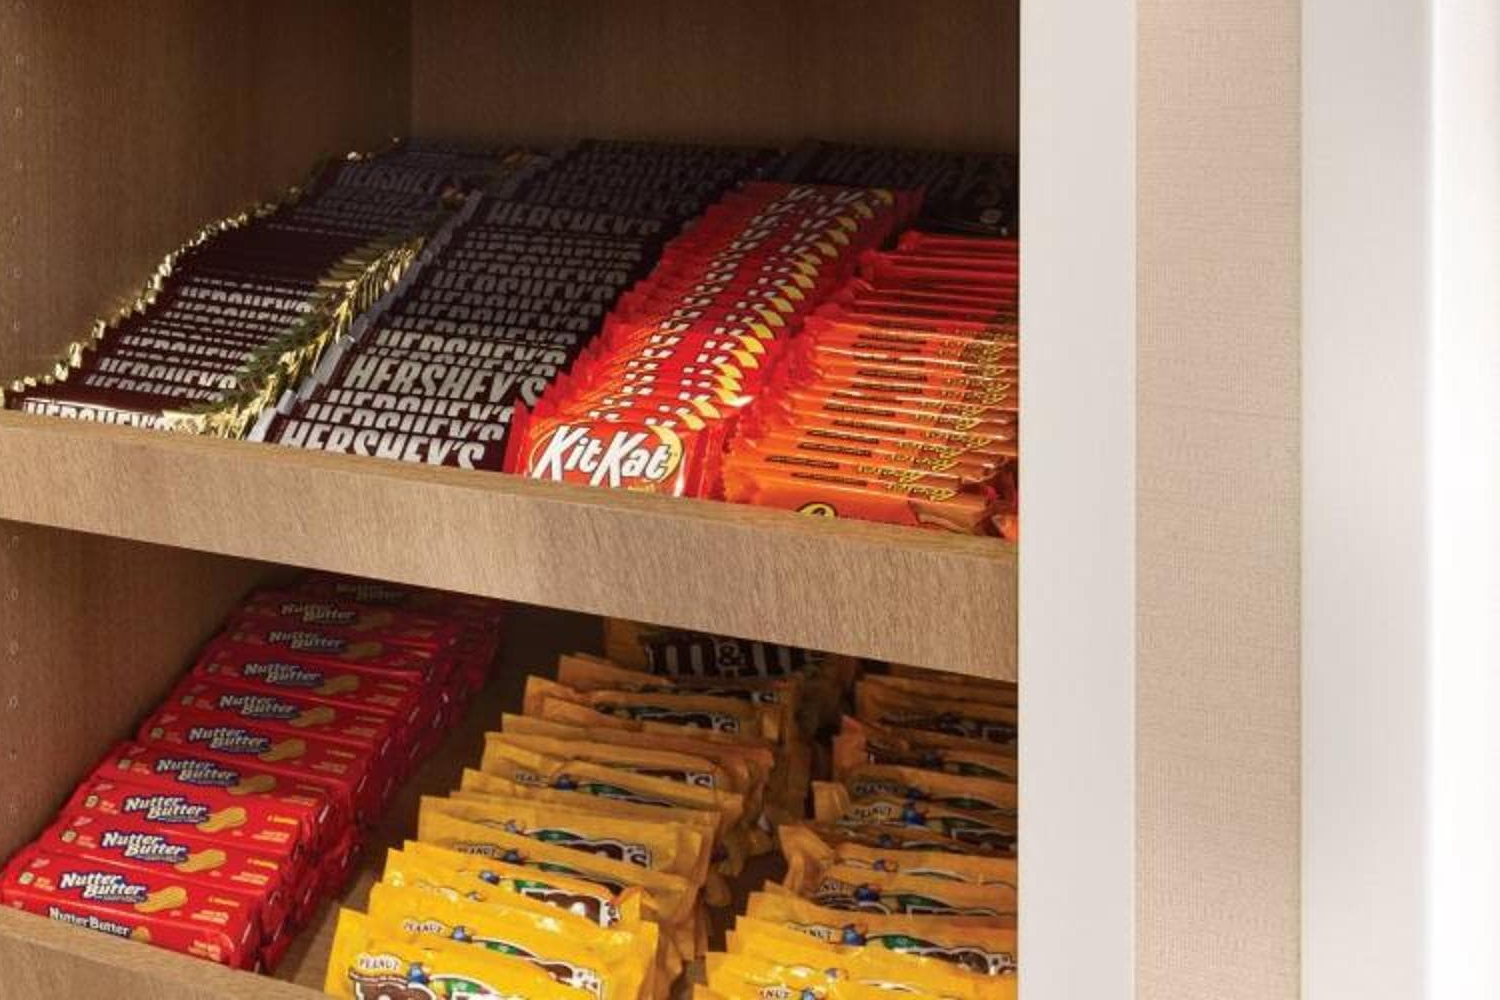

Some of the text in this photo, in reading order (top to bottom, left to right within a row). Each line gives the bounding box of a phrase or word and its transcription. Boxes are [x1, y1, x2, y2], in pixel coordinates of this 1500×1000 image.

[342, 353, 548, 408] HERSHEY'S
[219, 695, 277, 708] Nutter
[241, 703, 298, 715] Butter
[189, 728, 246, 741] Nutter
[210, 737, 268, 748] Butter
[156, 759, 216, 772] Nutter
[178, 769, 238, 781] Butter
[125, 796, 185, 811] Nutter
[147, 805, 208, 819] Butter
[102, 832, 164, 847] Nutter
[124, 844, 188, 857] Butter
[60, 872, 123, 889] Nutter
[83, 884, 147, 898] Butter
[49, 906, 131, 937] Nutter Butter
[359, 956, 399, 971] PEANUT
